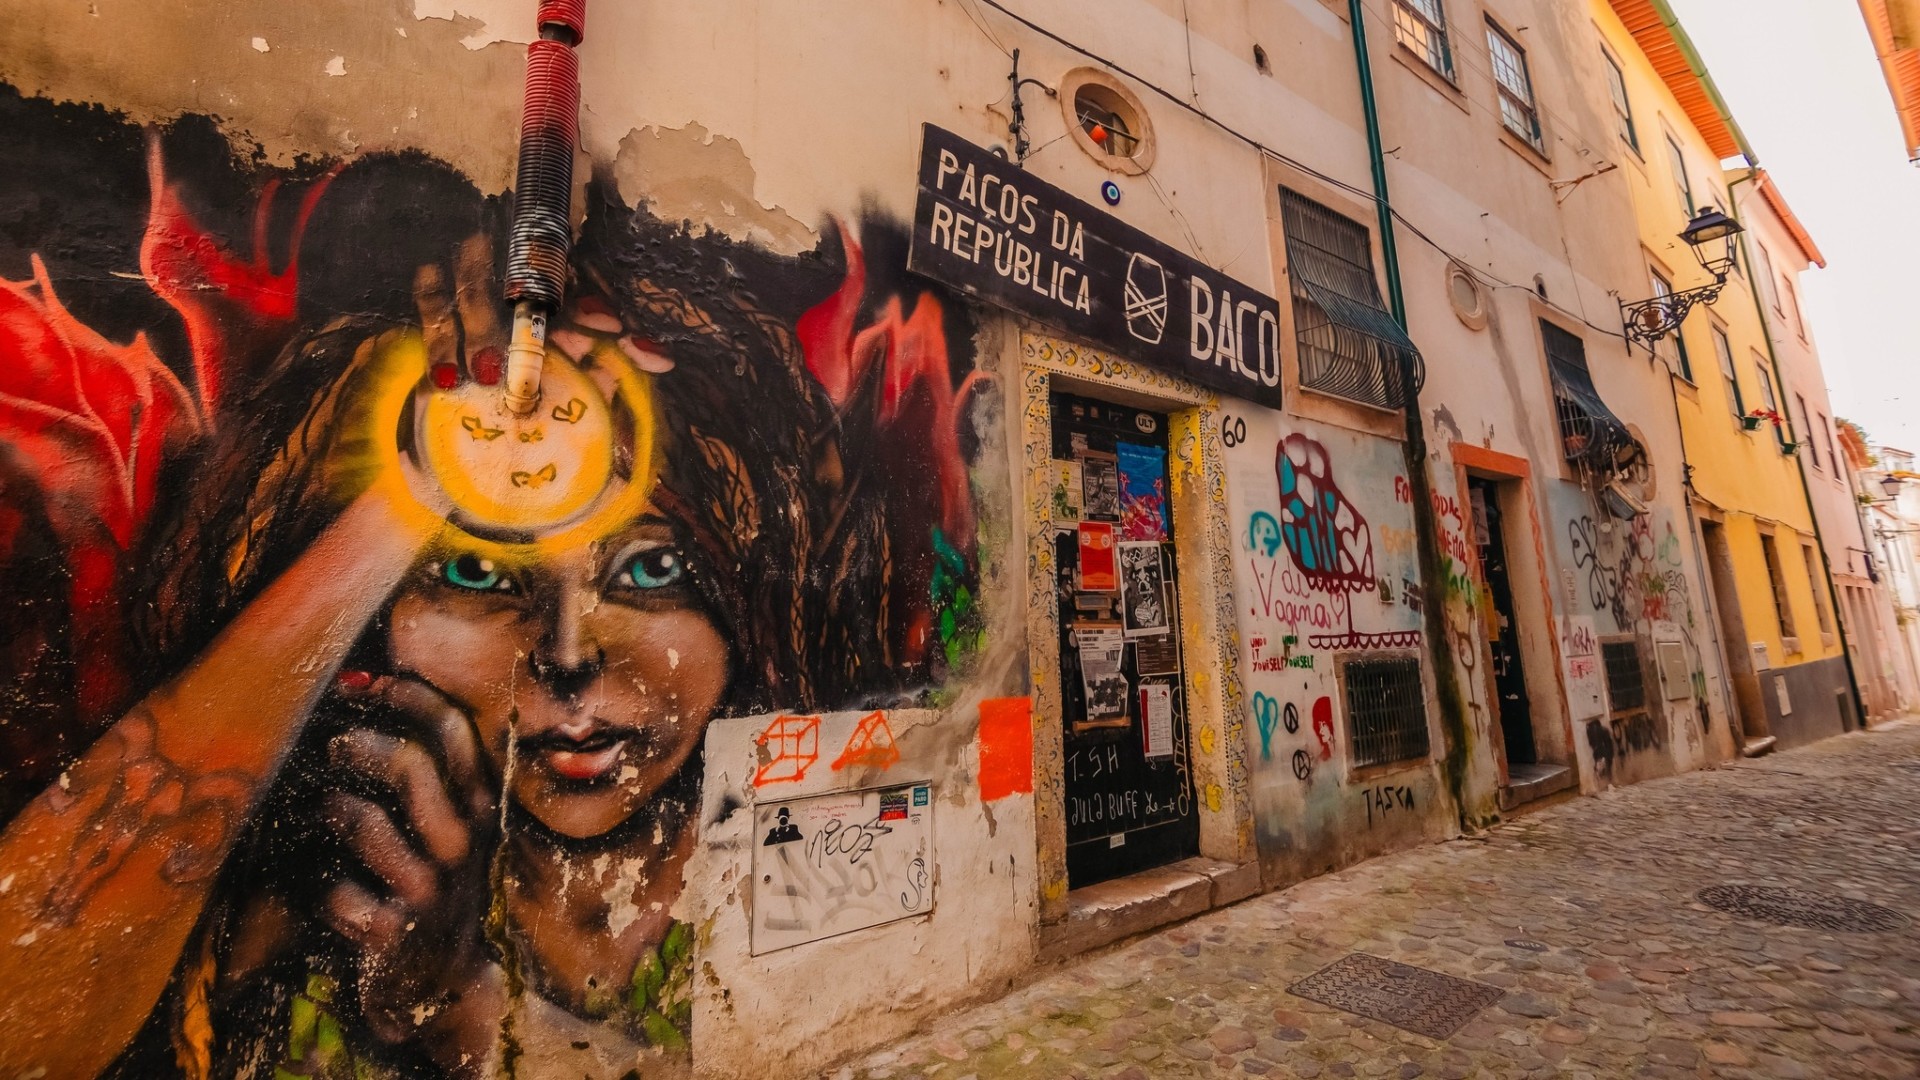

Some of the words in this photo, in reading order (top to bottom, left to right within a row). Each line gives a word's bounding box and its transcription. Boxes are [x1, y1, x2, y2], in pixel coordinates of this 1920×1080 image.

[936, 148, 1039, 235] PAÇOS
[1051, 209, 1085, 261] DA
[930, 201, 1091, 316] REPÚBLICA
[1190, 276, 1280, 388] BACO
[1137, 418, 1154, 429] ULT
[1222, 414, 1246, 448] 60
[1362, 785, 1415, 829] TASCA
